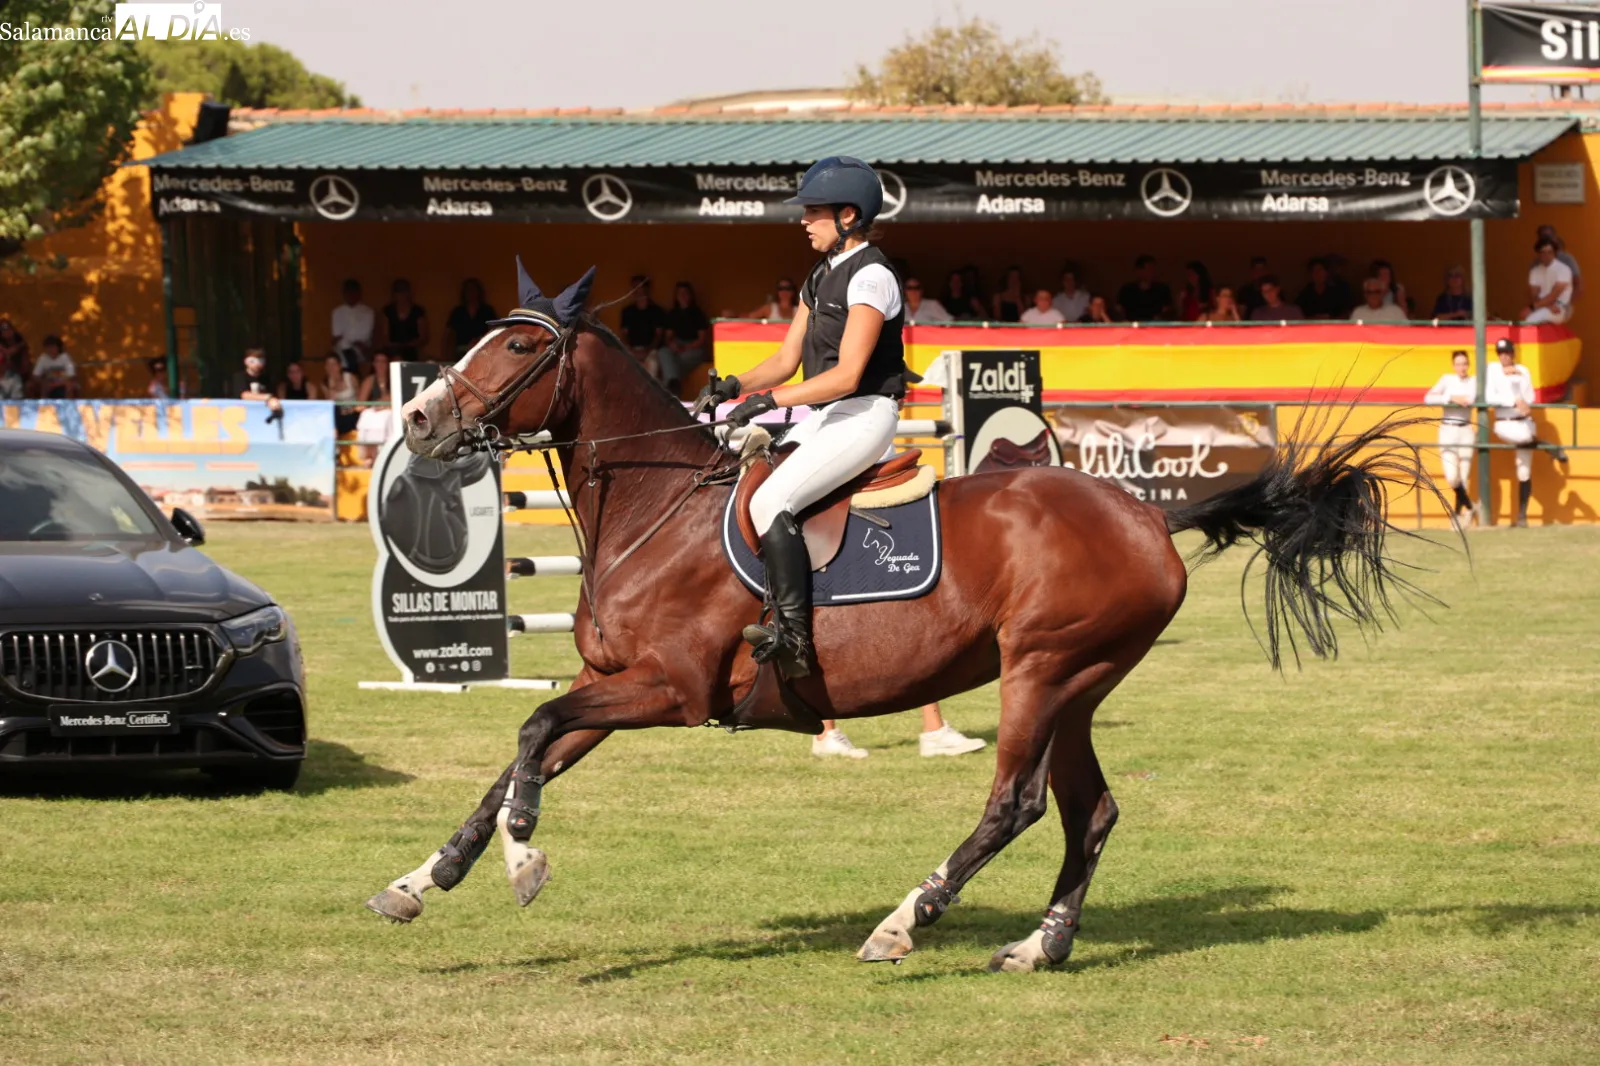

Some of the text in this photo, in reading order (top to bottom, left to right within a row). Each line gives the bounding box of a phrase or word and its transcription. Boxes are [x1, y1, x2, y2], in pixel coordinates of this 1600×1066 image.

[154, 174, 295, 193] Mercedes-Benz
[423, 176, 568, 192] Mercedes-Benz
[975, 169, 1126, 188] Mercedes-Benz
[1260, 169, 1410, 187] Mercedes-Benz
[158, 196, 221, 216] Adarsa
[426, 198, 493, 216] Adarsa
[700, 196, 765, 217] Adarsa
[976, 194, 1045, 214] Adarsa
[1261, 193, 1329, 213] Adarsa
[969, 361, 1026, 392] Zaldi
[874, 545, 919, 565] Yeguada
[888, 563, 920, 574] De Gea
[392, 590, 498, 613] SILLAS DE MONTAR
[412, 642, 493, 659] www.zaldi.com
[60, 714, 168, 726] Mercedes-Benz Certified
